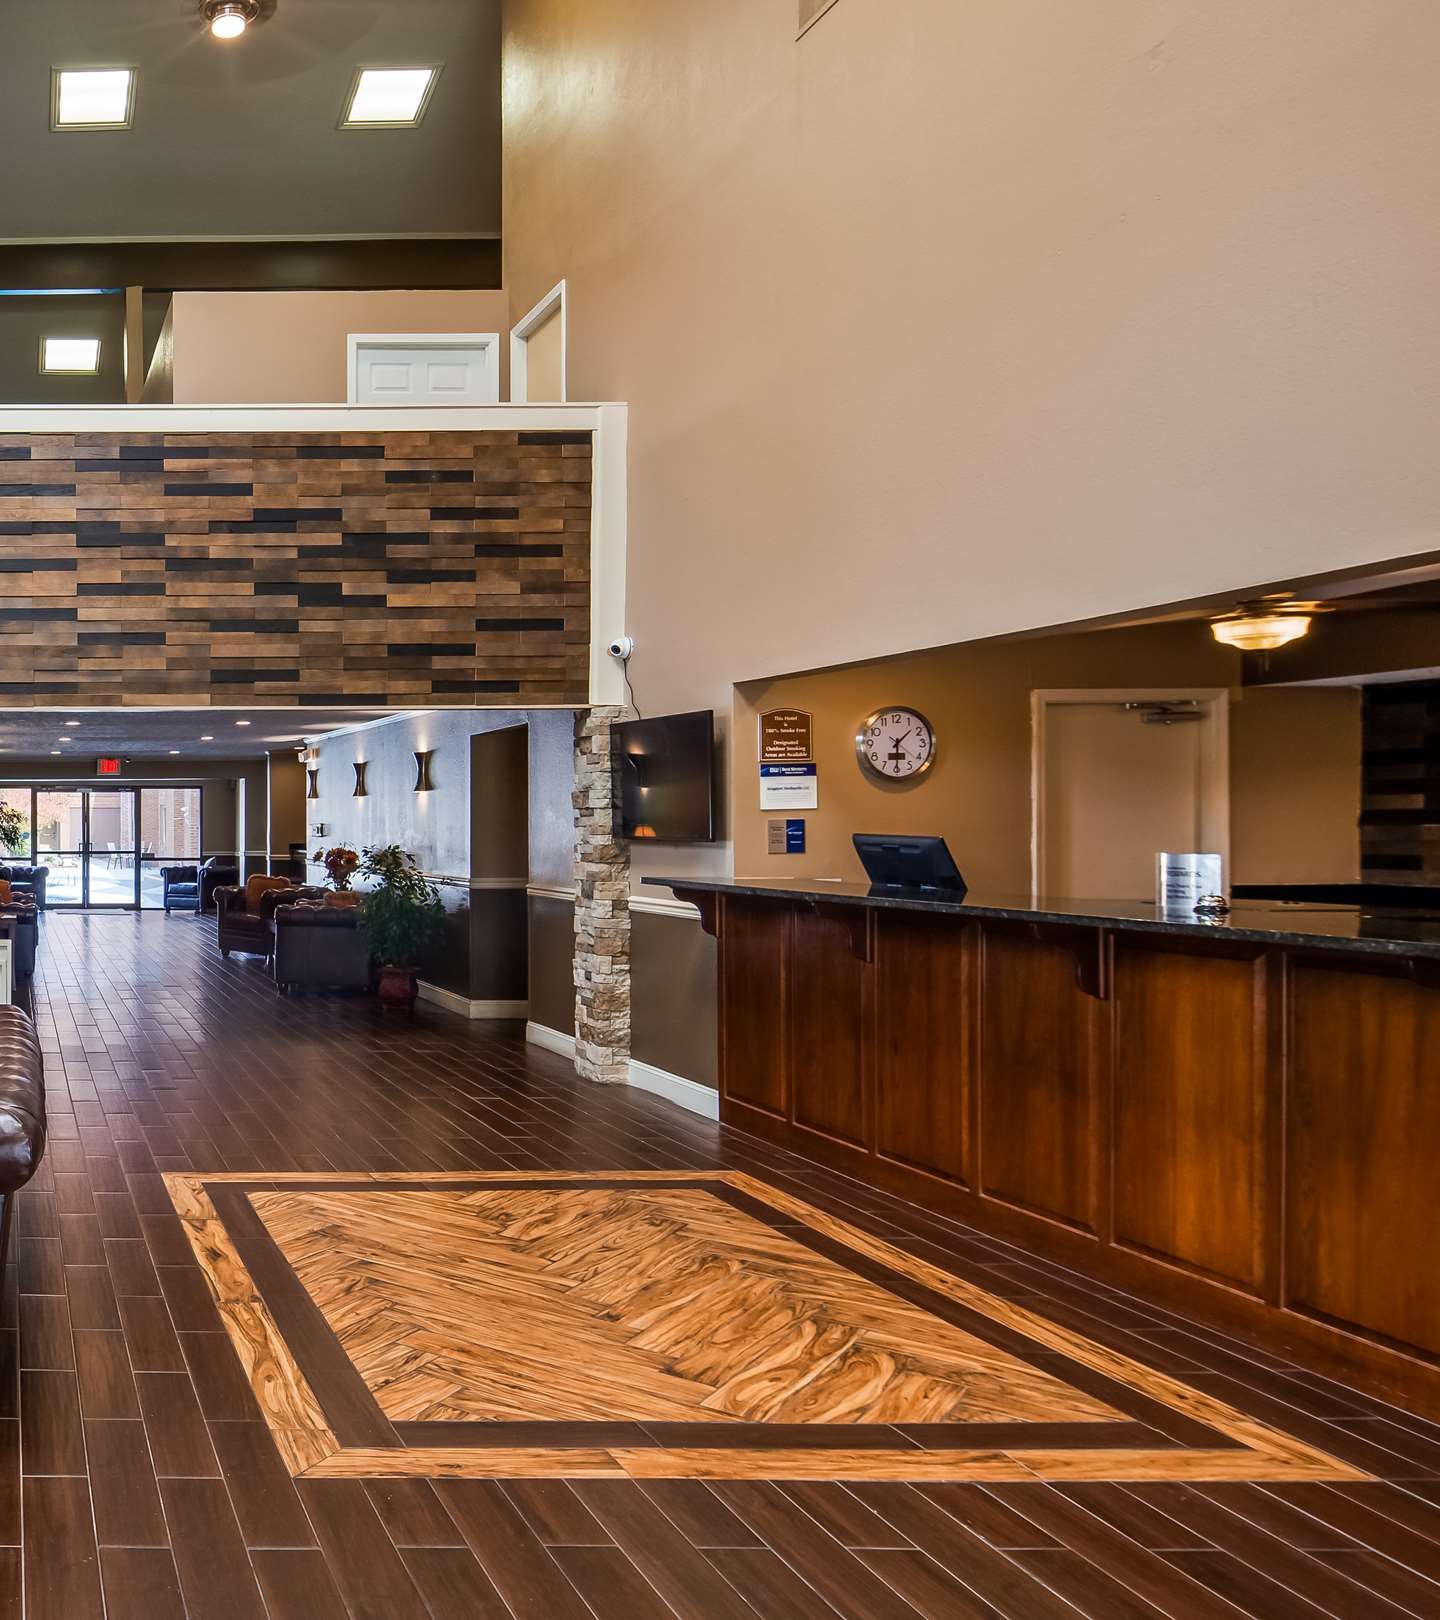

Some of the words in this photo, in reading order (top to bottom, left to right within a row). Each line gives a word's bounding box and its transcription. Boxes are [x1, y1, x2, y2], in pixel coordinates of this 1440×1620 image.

[880, 717, 887, 727] 11
[891, 713, 901, 724] 12
[906, 717, 911, 727] 1
[870, 727, 881, 737] 10
[915, 726, 923, 737] 2
[866, 739, 874, 749] 9
[919, 738, 927, 748] 3
[870, 751, 879, 762] 8
[915, 751, 922, 760] 4
[881, 761, 888, 771] 7
[906, 760, 913, 771] 5
